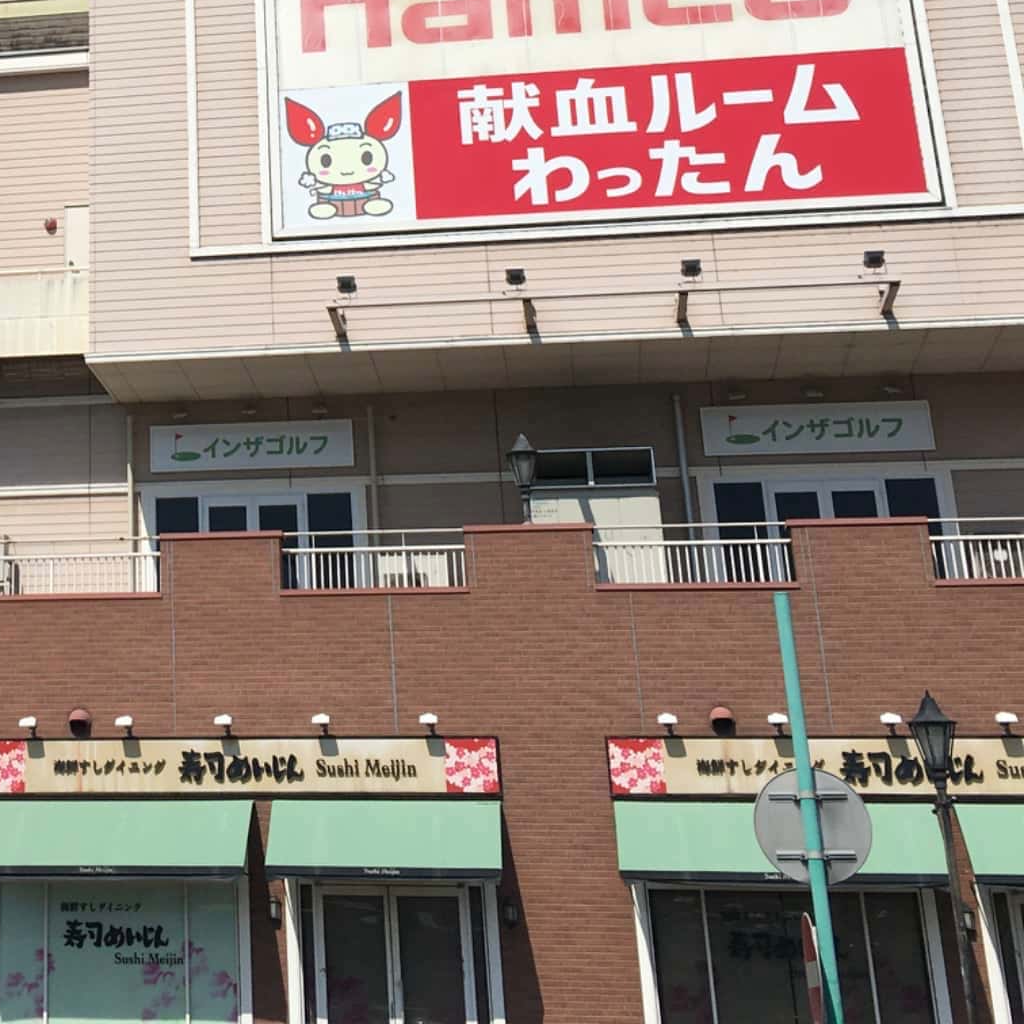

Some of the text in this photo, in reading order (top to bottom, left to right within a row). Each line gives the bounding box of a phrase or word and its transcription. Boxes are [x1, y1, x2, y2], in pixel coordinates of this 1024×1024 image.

[458, 63, 861, 145] 献血ルーム
[511, 133, 823, 207] わったん
[762, 416, 903, 442] インザゴルフ
[203, 434, 329, 459] インザゴルフ
[178, 748, 304, 785] 寿司めいじん
[315, 758, 360, 778] Sushi
[364, 758, 417, 782] Meijin
[839, 748, 984, 787] 寿司めじん
[63, 919, 169, 948] 寿司めいじん
[114, 952, 144, 965] Sushi
